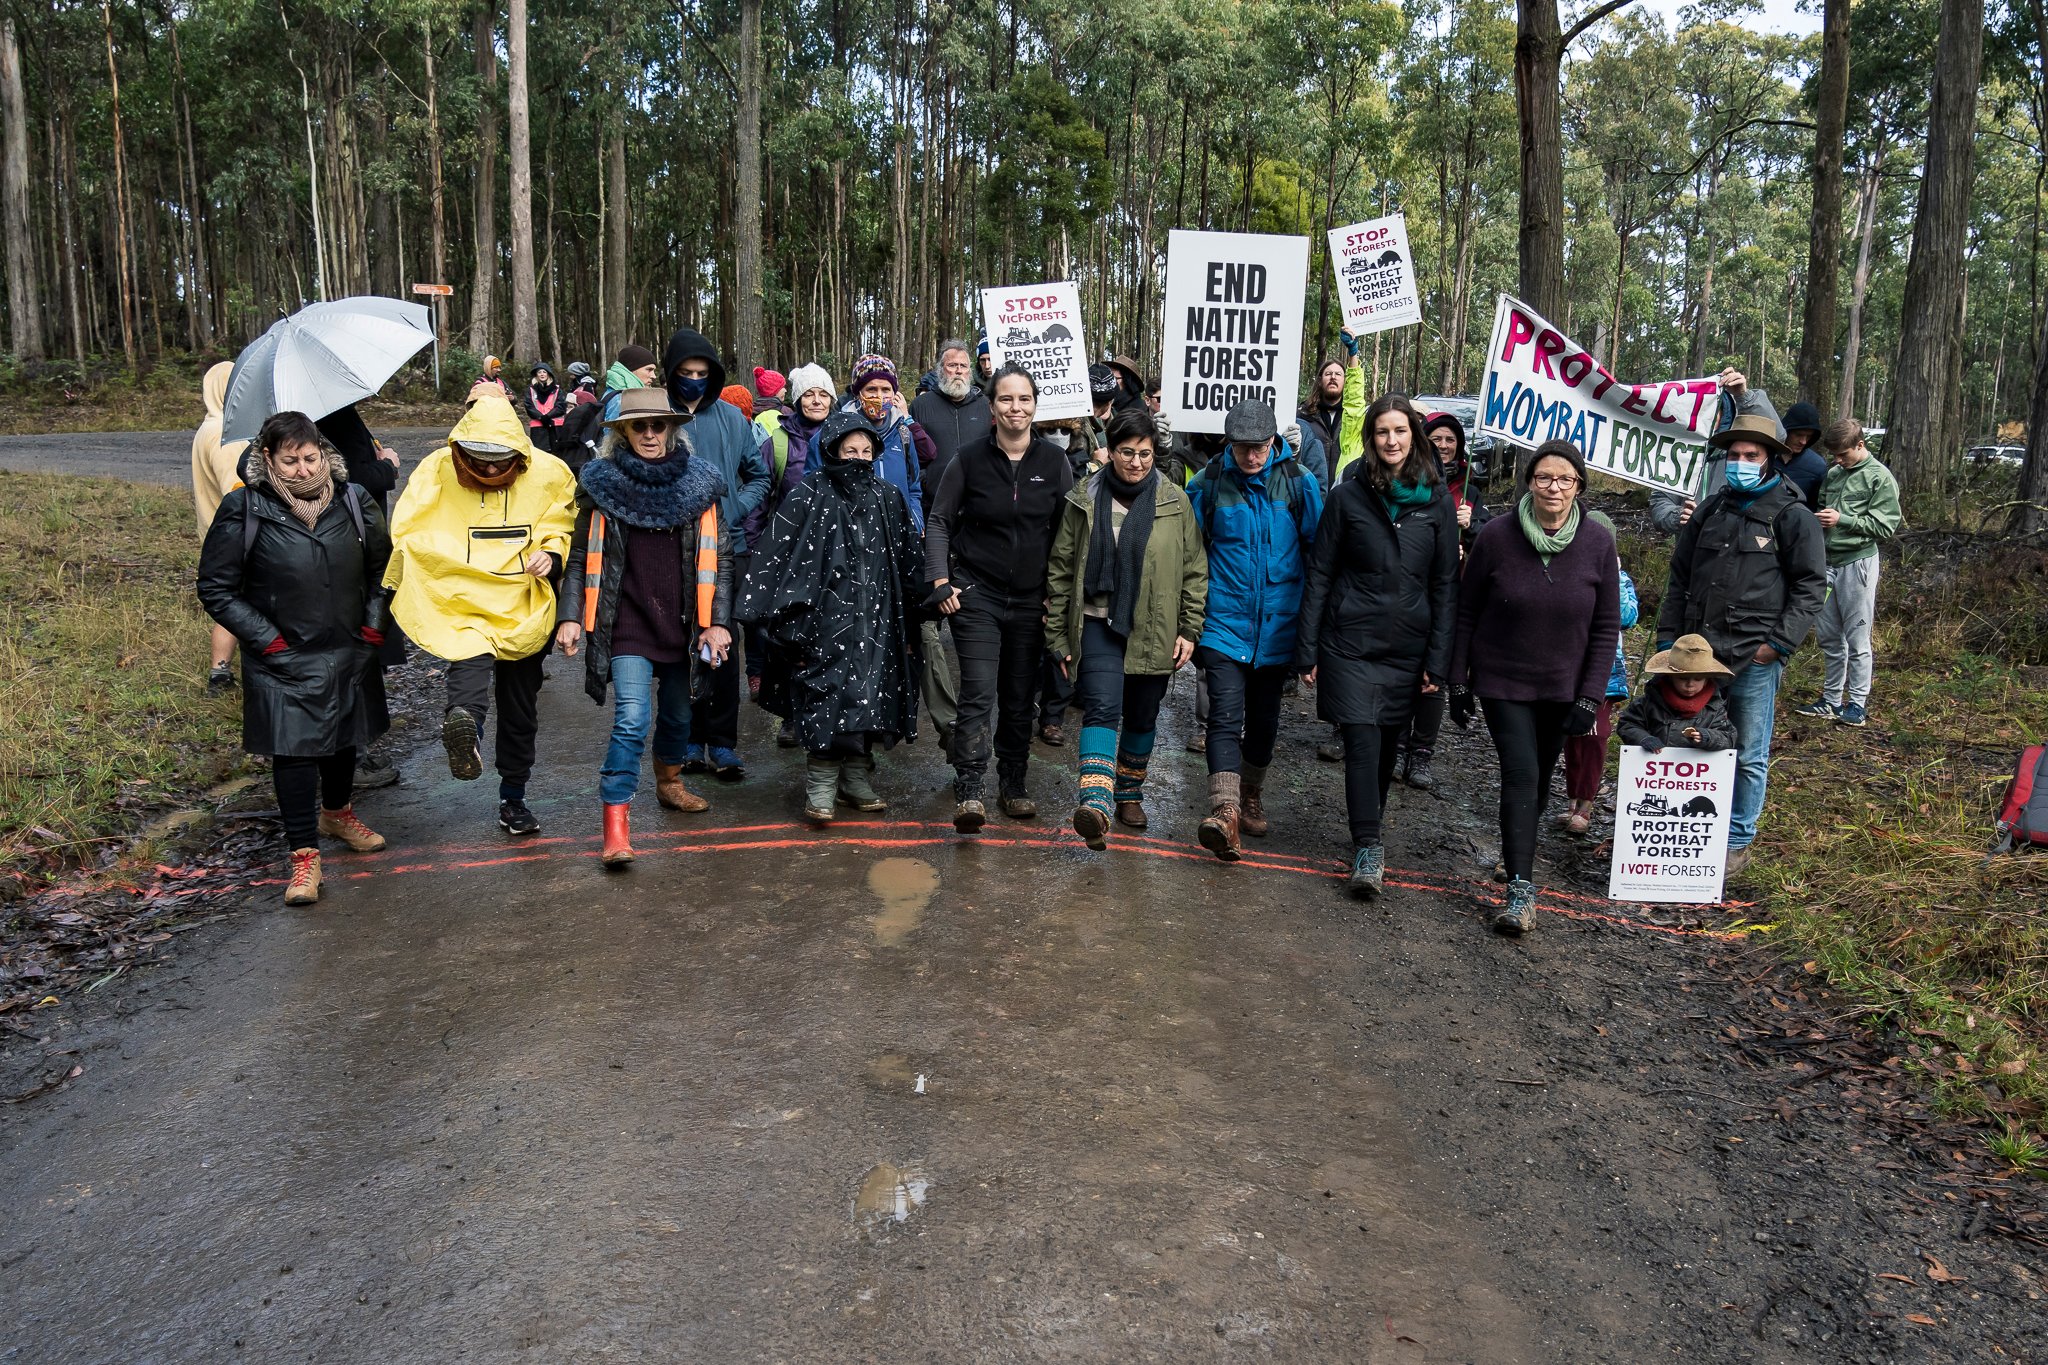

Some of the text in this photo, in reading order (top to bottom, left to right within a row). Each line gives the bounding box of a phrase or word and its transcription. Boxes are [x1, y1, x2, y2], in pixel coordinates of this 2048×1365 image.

[1346, 227, 1389, 246] STOP
[1205, 261, 1267, 304] END
[1348, 267, 1401, 286] PROTECT
[1349, 276, 1403, 295] WOMBAT
[1004, 295, 1058, 312] STOP
[1356, 286, 1400, 303] FOREST
[1353, 305, 1374, 317] VOTE
[1375, 296, 1413, 312] FORESTS
[1186, 306, 1281, 346] NATIVE
[1004, 345, 1072, 361] PROTECT
[1183, 345, 1279, 382] FOREST
[1501, 308, 1717, 432] PROTECT
[1032, 368, 1069, 381] REST
[1484, 371, 1705, 490] WOMBAT FOREST
[1645, 761, 1710, 778] STOP
[1632, 820, 1713, 833] PROTECT
[1631, 833, 1712, 846] WOMBAT
[1637, 846, 1704, 858] FOREST
[1620, 863, 1716, 877] I VOTE FORESTS
